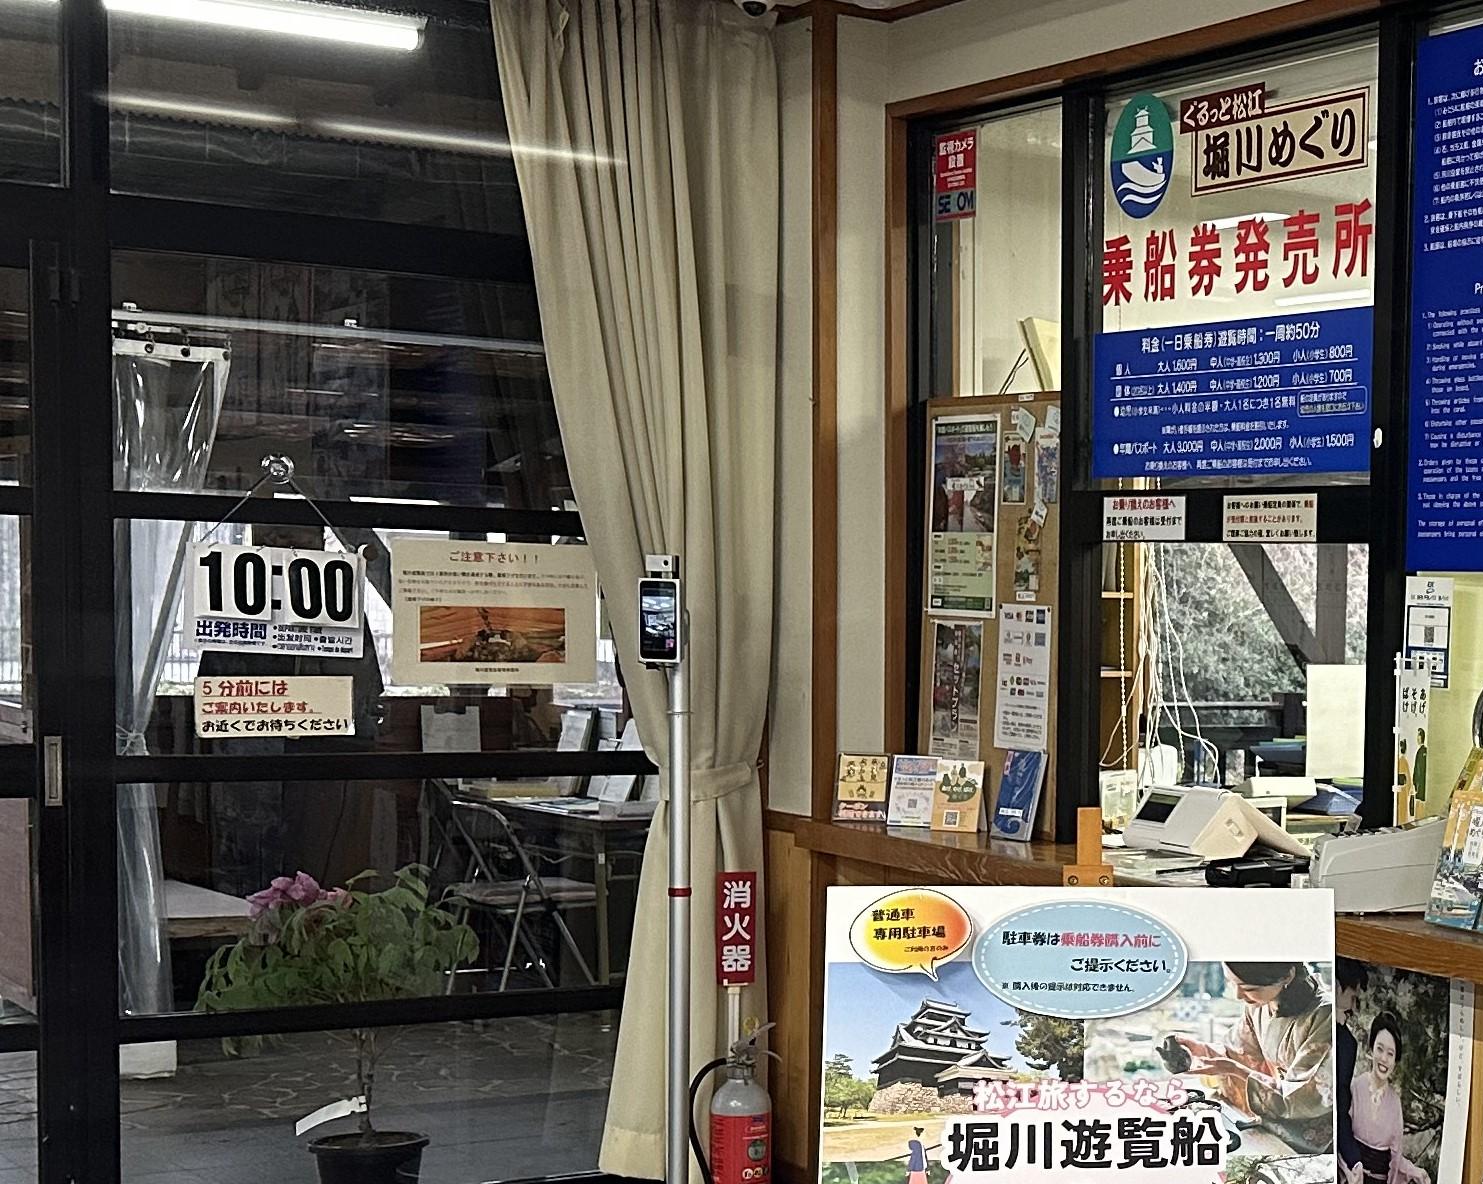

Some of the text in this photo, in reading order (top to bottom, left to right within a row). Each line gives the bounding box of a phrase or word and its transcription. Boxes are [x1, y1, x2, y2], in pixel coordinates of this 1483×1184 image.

[1184, 91, 1263, 127] ぐるっと松江
[1203, 107, 1356, 181] 堀川めぐり
[1102, 198, 1375, 307] 乗船券発売所
[1157, 360, 1171, 373] 大人
[1157, 381, 1171, 394] 大人
[449, 550, 540, 565] ご注意下さい！！
[200, 551, 354, 623] 10:00
[196, 620, 267, 640] 出発時間
[219, 681, 289, 697] 分前には
[202, 702, 315, 714] ご案内いたします。
[201, 718, 349, 733] お近くでお待ちください
[722, 880, 752, 973] 消火器
[873, 925, 946, 941] 専用駐車場
[1002, 931, 1161, 948] 駐車券は乗船券購入前に
[1070, 957, 1171, 974] ご提示ください。
[974, 1079, 1190, 1112] 松江旅するなら
[947, 1118, 1224, 1173] 堀川遊覧船
